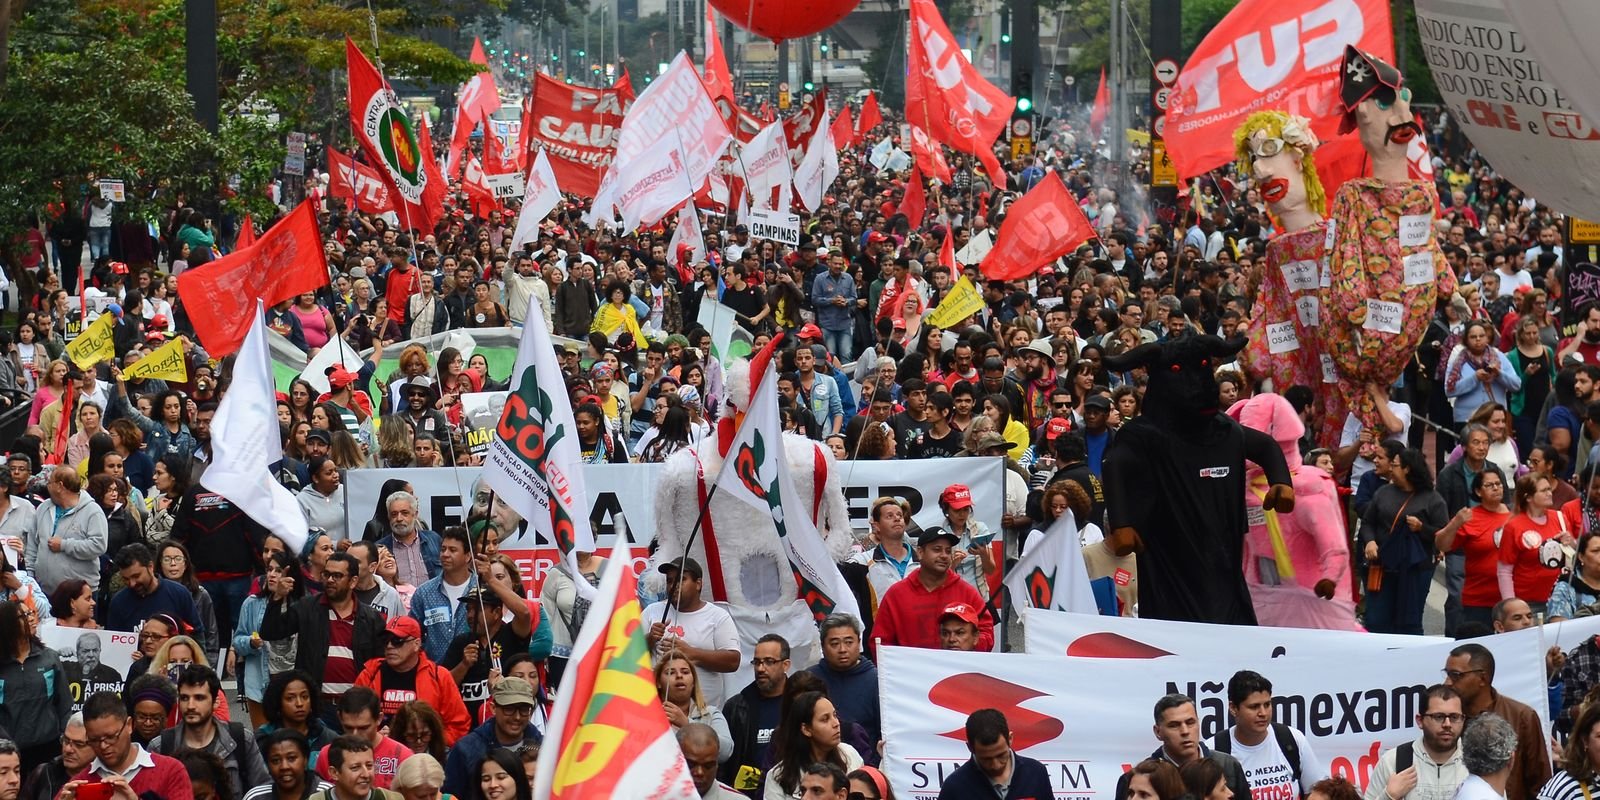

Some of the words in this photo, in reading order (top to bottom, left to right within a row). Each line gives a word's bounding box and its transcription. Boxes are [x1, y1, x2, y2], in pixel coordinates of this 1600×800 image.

[1451, 49, 1480, 73] DO
[1468, 77, 1498, 100] DE
[1500, 79, 1547, 108] SÃO
[367, 97, 385, 138] CENTRAL
[1528, 120, 1540, 135] e
[495, 185, 514, 196] LINS
[753, 222, 798, 243] CAMPINAS
[1369, 302, 1399, 313] CONTRA
[493, 455, 503, 468] NAS
[538, 498, 549, 509] DA
[111, 634, 136, 645] PCO
[385, 691, 416, 702] NÃO
[1165, 680, 1233, 739] Nã
[1254, 764, 1288, 777] MEXAM
[1254, 775, 1289, 787] NOSSOS
